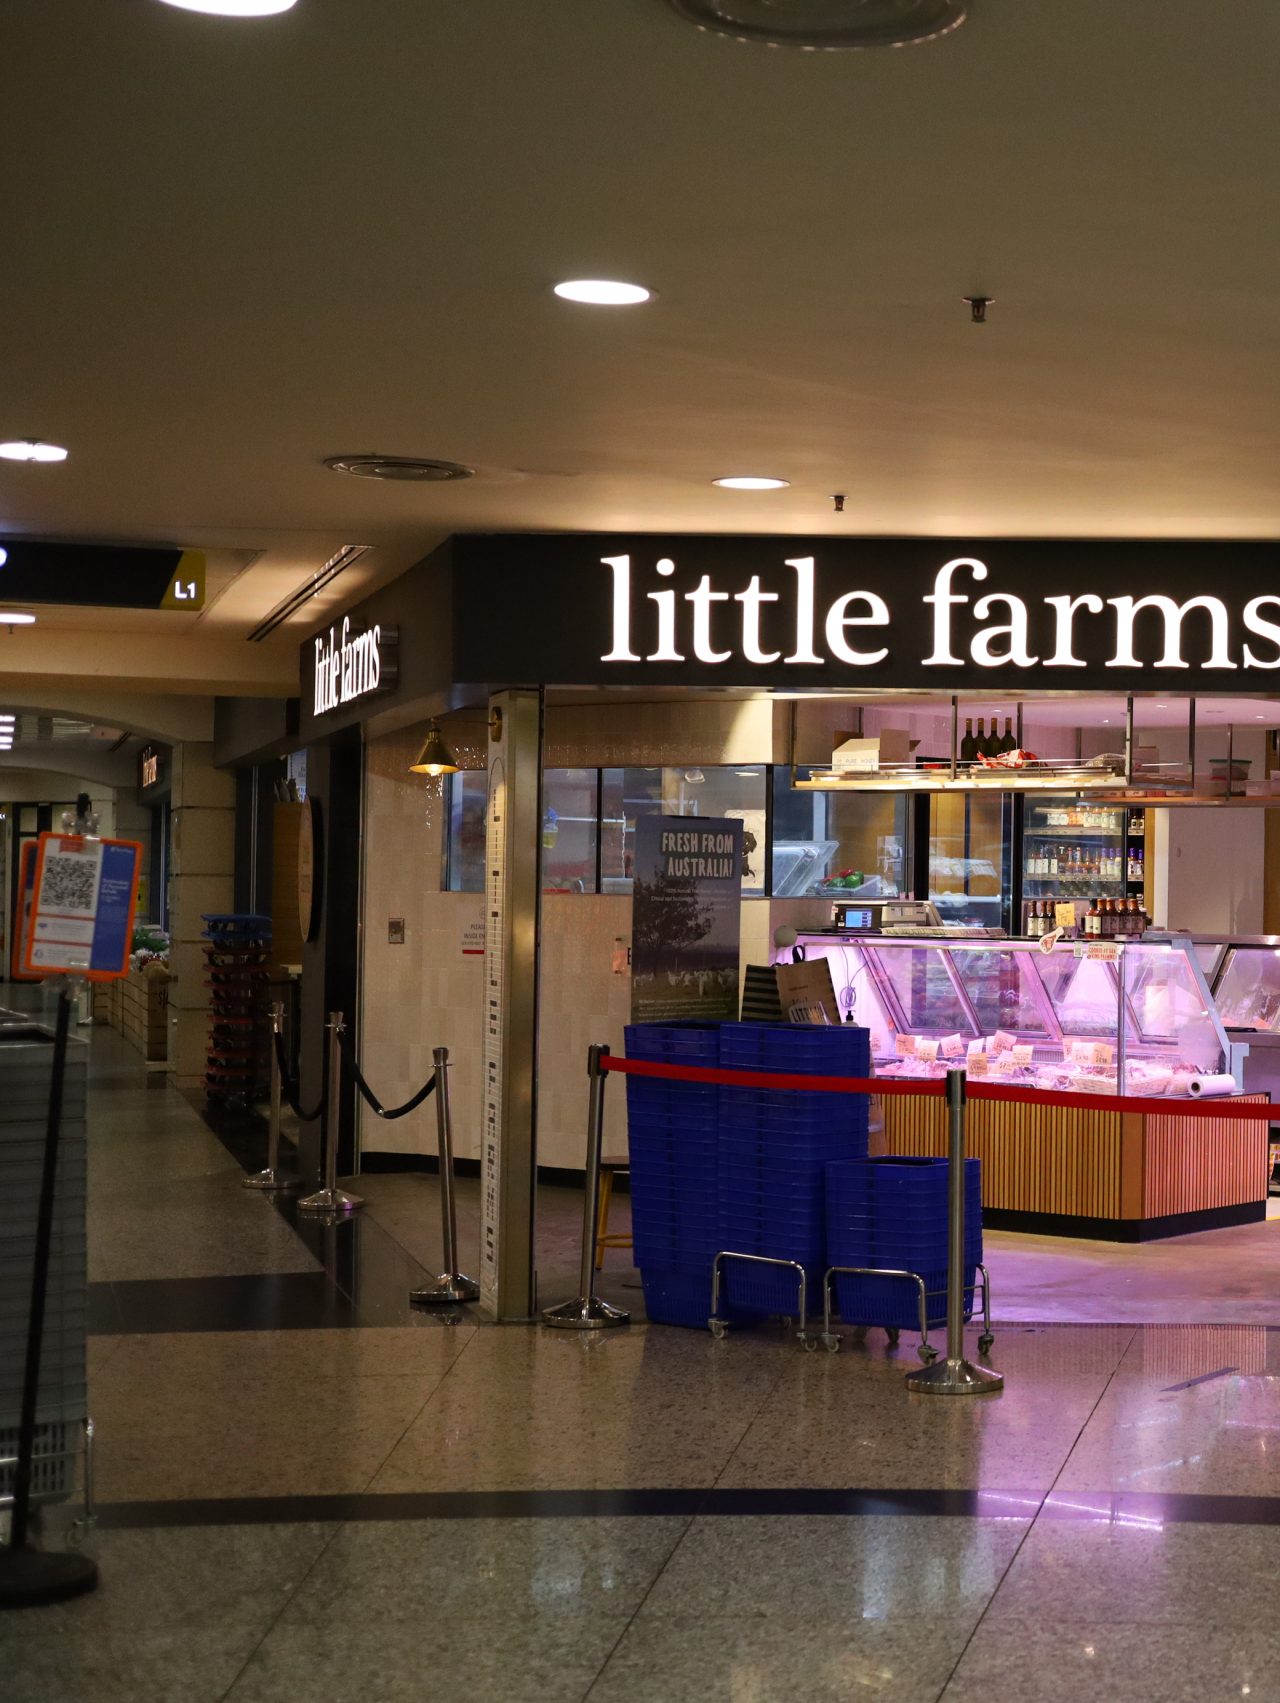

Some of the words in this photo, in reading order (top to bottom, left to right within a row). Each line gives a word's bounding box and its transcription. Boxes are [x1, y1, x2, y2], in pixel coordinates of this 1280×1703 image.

[174, 581, 196, 599] L1
[600, 554, 890, 667] little
[313, 627, 340, 716] little
[340, 616, 381, 703] farms
[662, 832, 699, 853] FRESH
[702, 833, 734, 854] FROM
[668, 856, 733, 878] AUSTRALIA!
